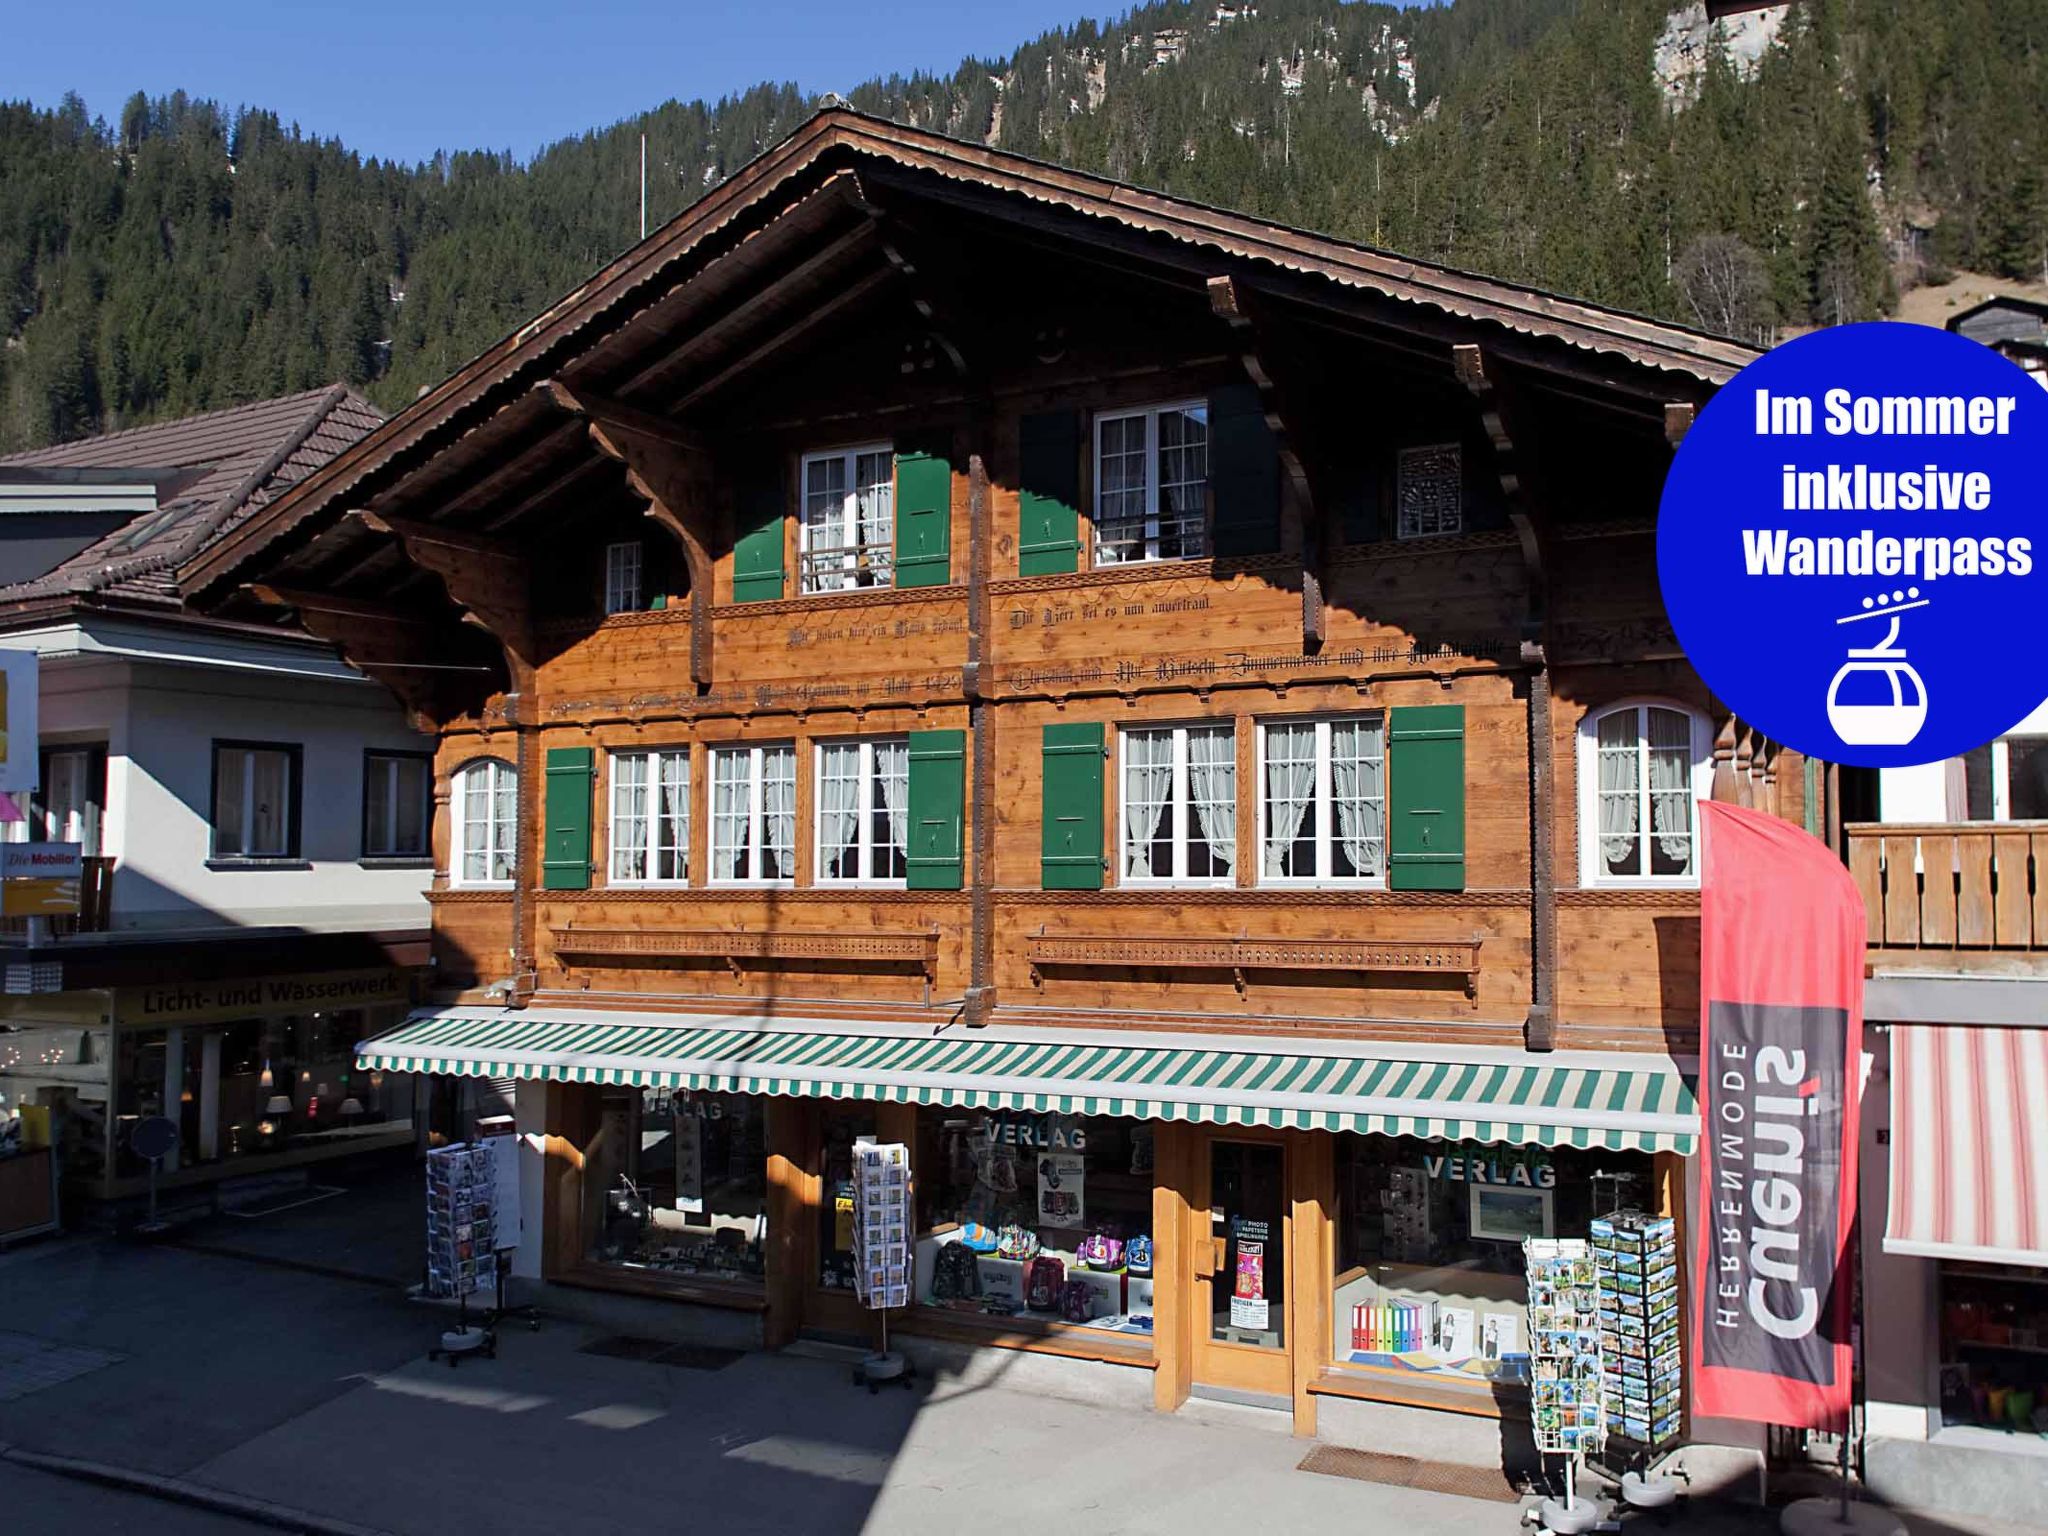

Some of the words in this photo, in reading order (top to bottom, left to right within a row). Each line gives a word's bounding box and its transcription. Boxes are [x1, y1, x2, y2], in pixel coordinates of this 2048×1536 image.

[144, 988, 211, 1014] Licht-
[217, 982, 262, 1007] und
[269, 972, 400, 1002] Wasserwerk
[986, 1121, 1087, 1150] VERLAG
[1424, 1155, 1556, 1188] VERLAG
